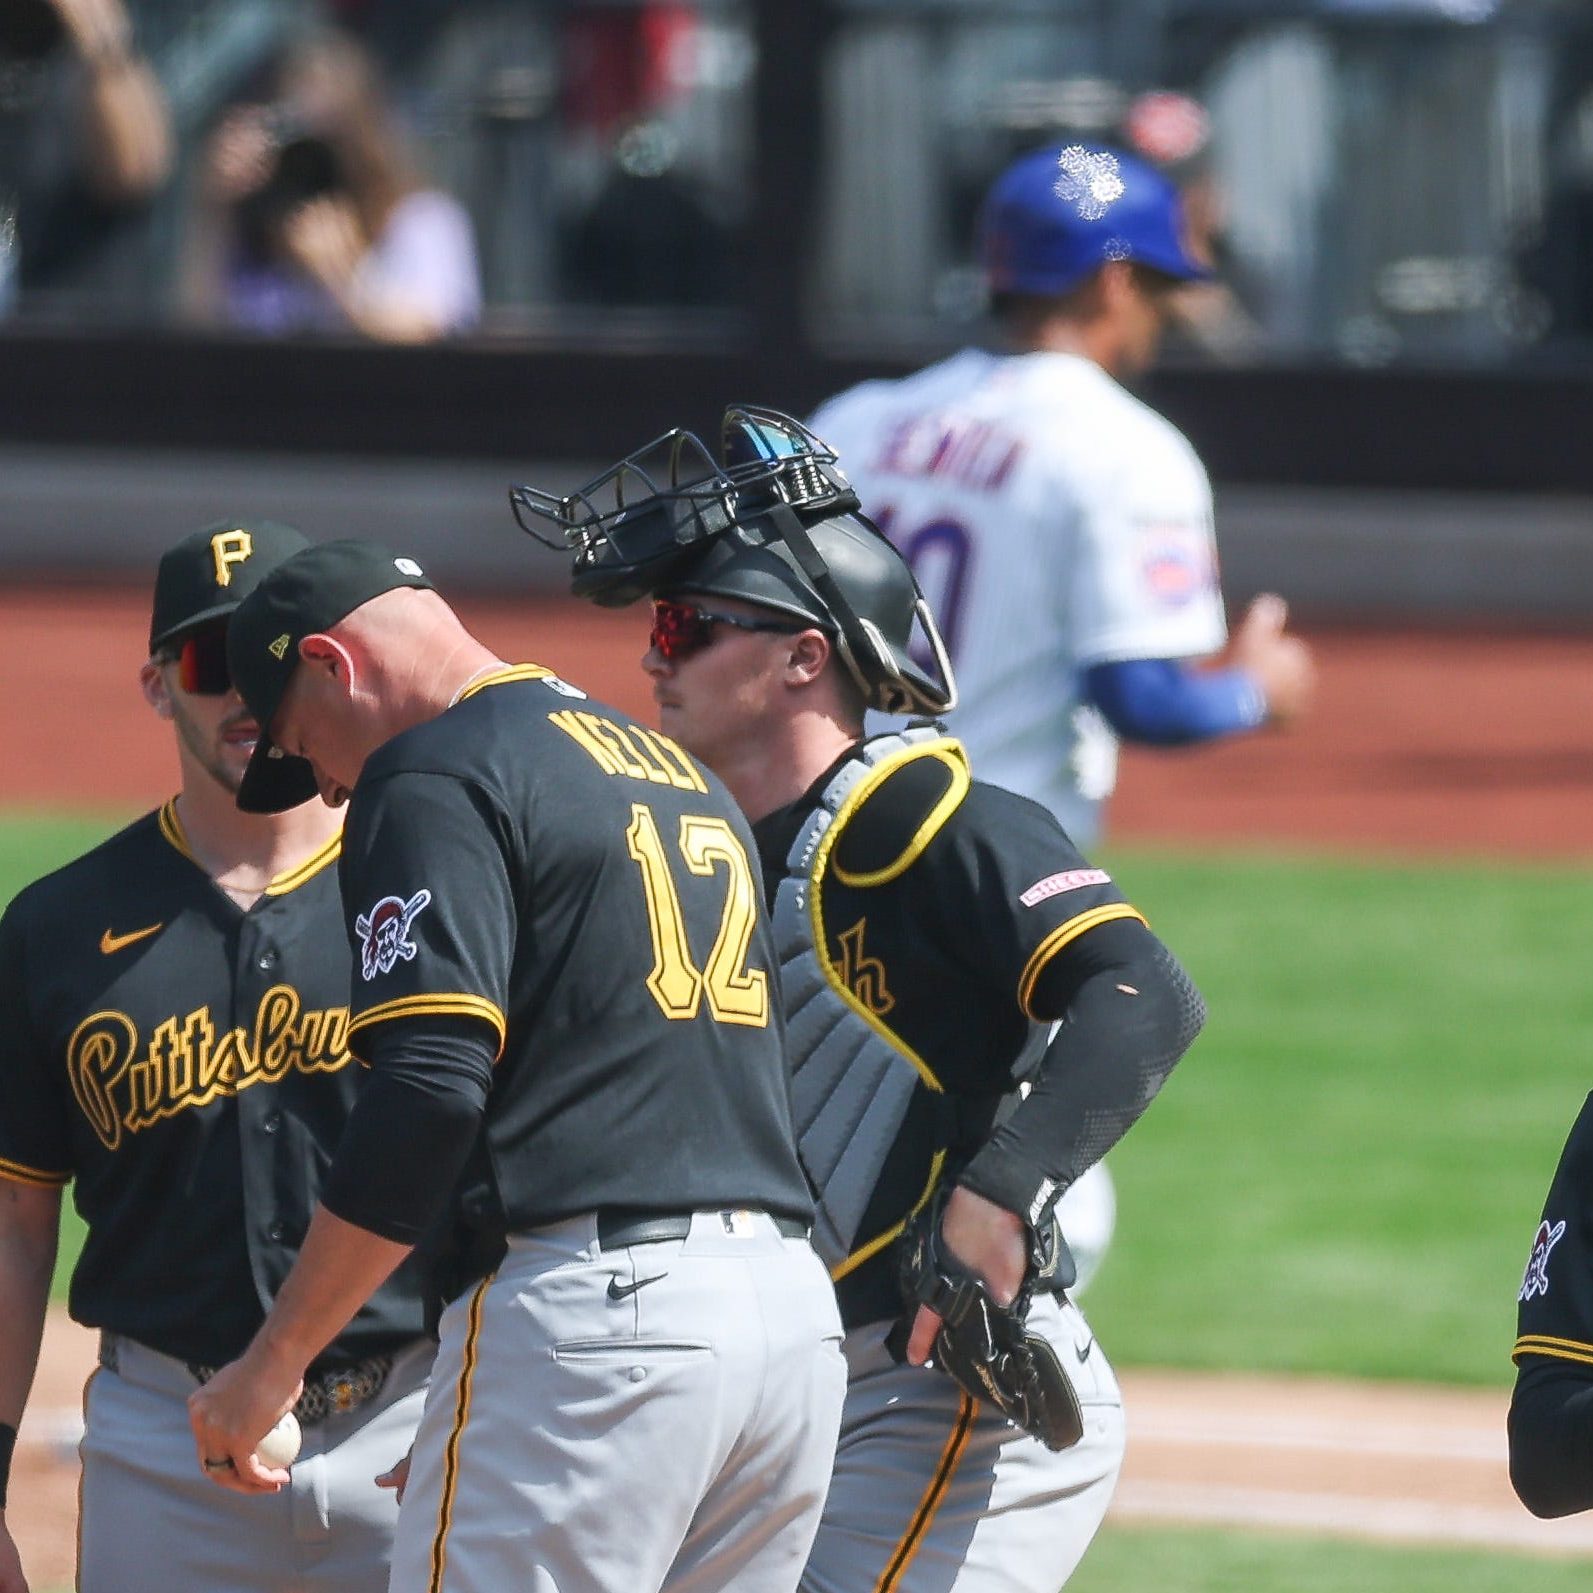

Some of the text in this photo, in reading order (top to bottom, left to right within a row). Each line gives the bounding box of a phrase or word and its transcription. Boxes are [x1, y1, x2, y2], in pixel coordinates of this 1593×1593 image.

[211, 529, 252, 587] P
[547, 709, 709, 795] KELLY
[626, 802, 770, 1028] 12
